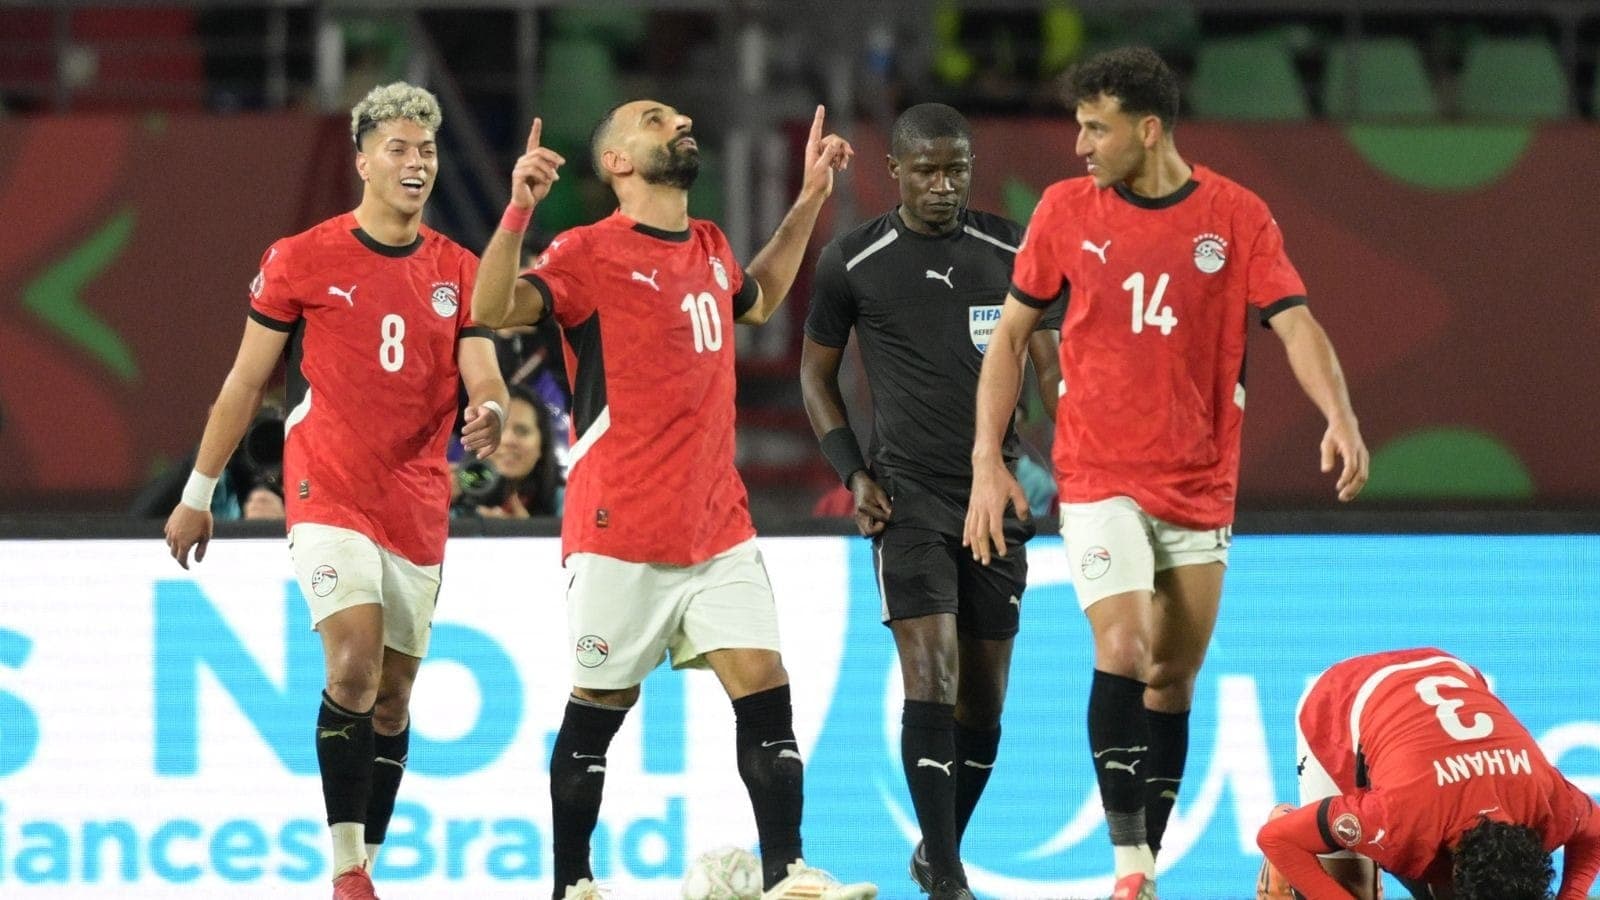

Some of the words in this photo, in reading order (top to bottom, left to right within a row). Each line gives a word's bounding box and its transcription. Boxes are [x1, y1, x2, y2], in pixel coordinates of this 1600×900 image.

[680, 291, 723, 353] 10
[973, 309, 1001, 321] FIFA
[1122, 271, 1178, 335] 14
[379, 313, 405, 372] 8
[1415, 675, 1494, 741] 3
[1433, 748, 1532, 787] M.HANY
[0, 800, 326, 883] ances
